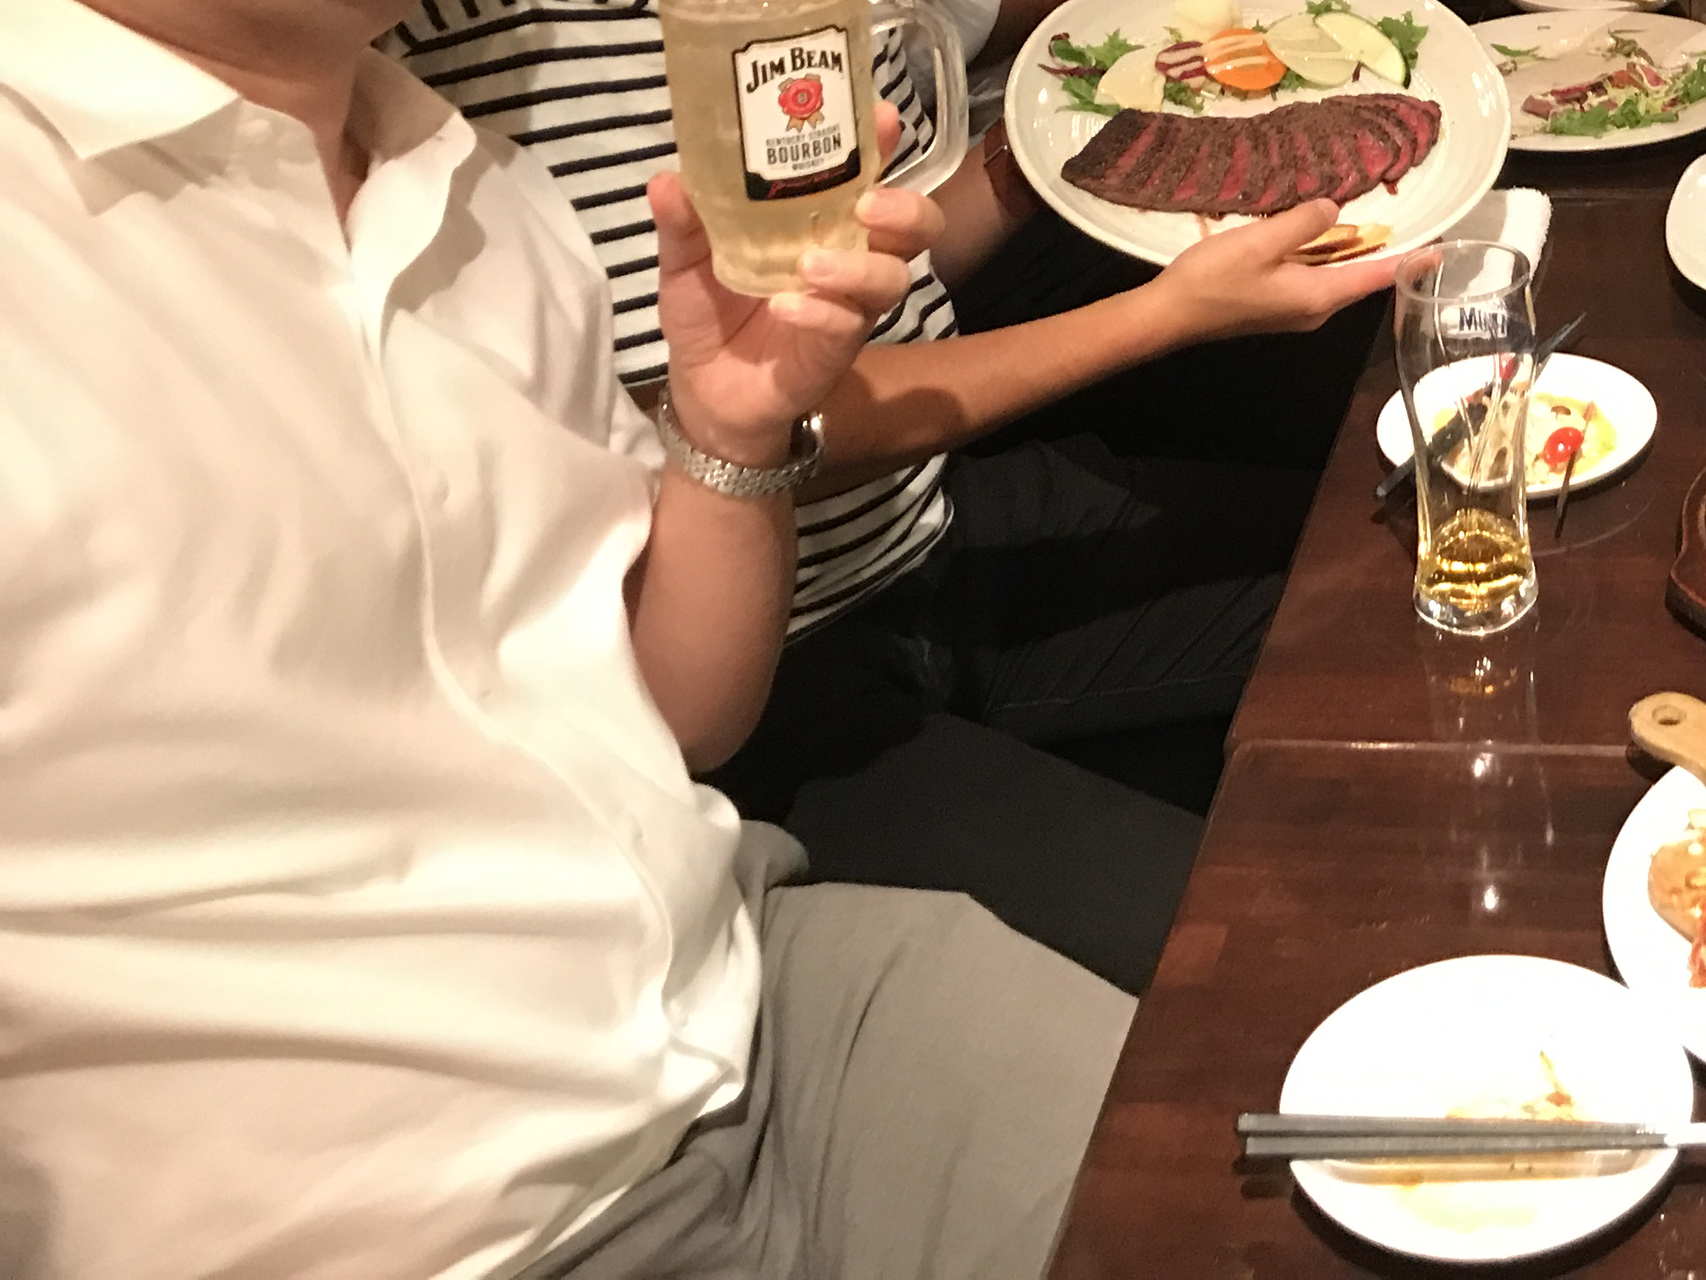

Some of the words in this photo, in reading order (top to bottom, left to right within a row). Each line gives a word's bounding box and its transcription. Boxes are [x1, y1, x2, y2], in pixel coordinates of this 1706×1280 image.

[746, 56, 786, 93] JIM
[790, 47, 843, 73] BEAM
[766, 133, 842, 166] BOURBON
